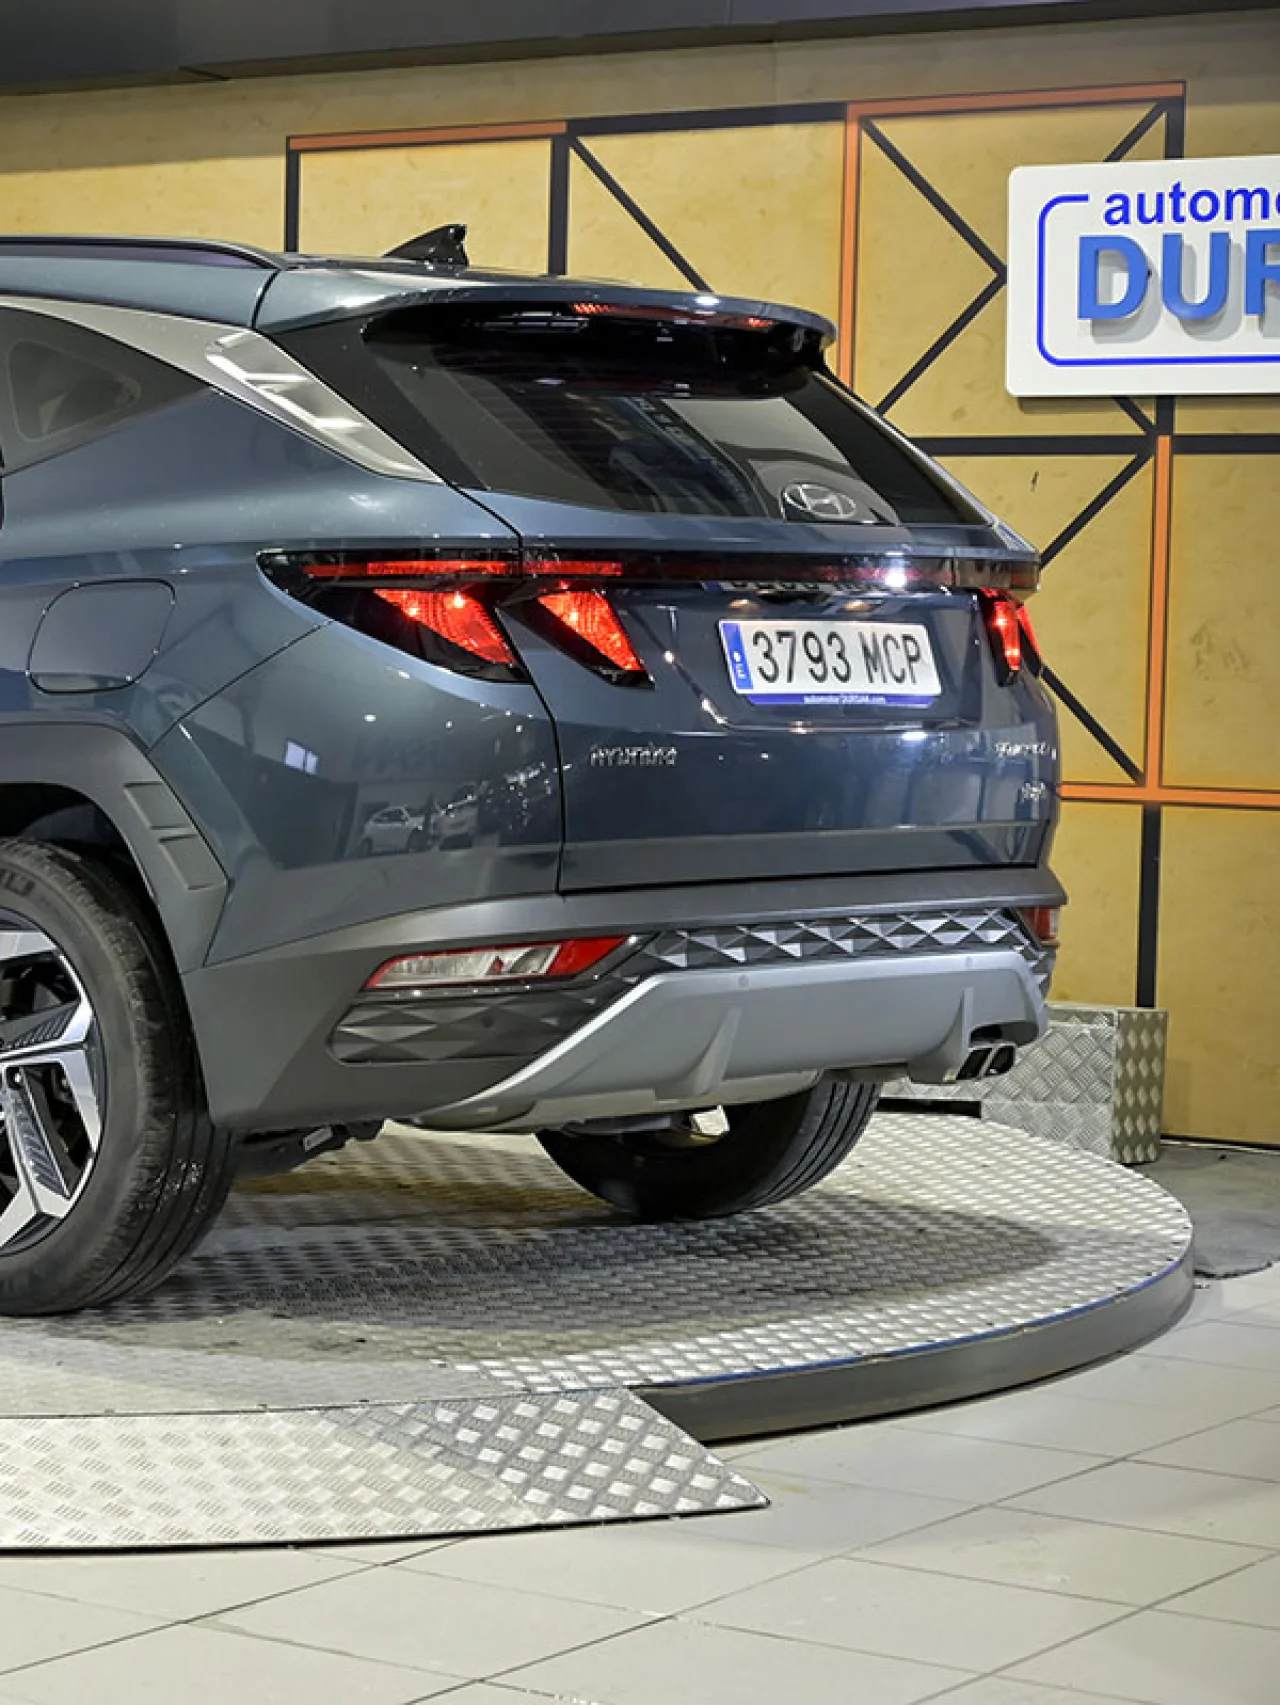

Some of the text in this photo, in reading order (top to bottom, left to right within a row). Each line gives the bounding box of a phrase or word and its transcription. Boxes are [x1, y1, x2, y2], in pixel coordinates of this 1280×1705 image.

[1104, 181, 1280, 226] autom
[753, 630, 921, 684] 3793 MCP
